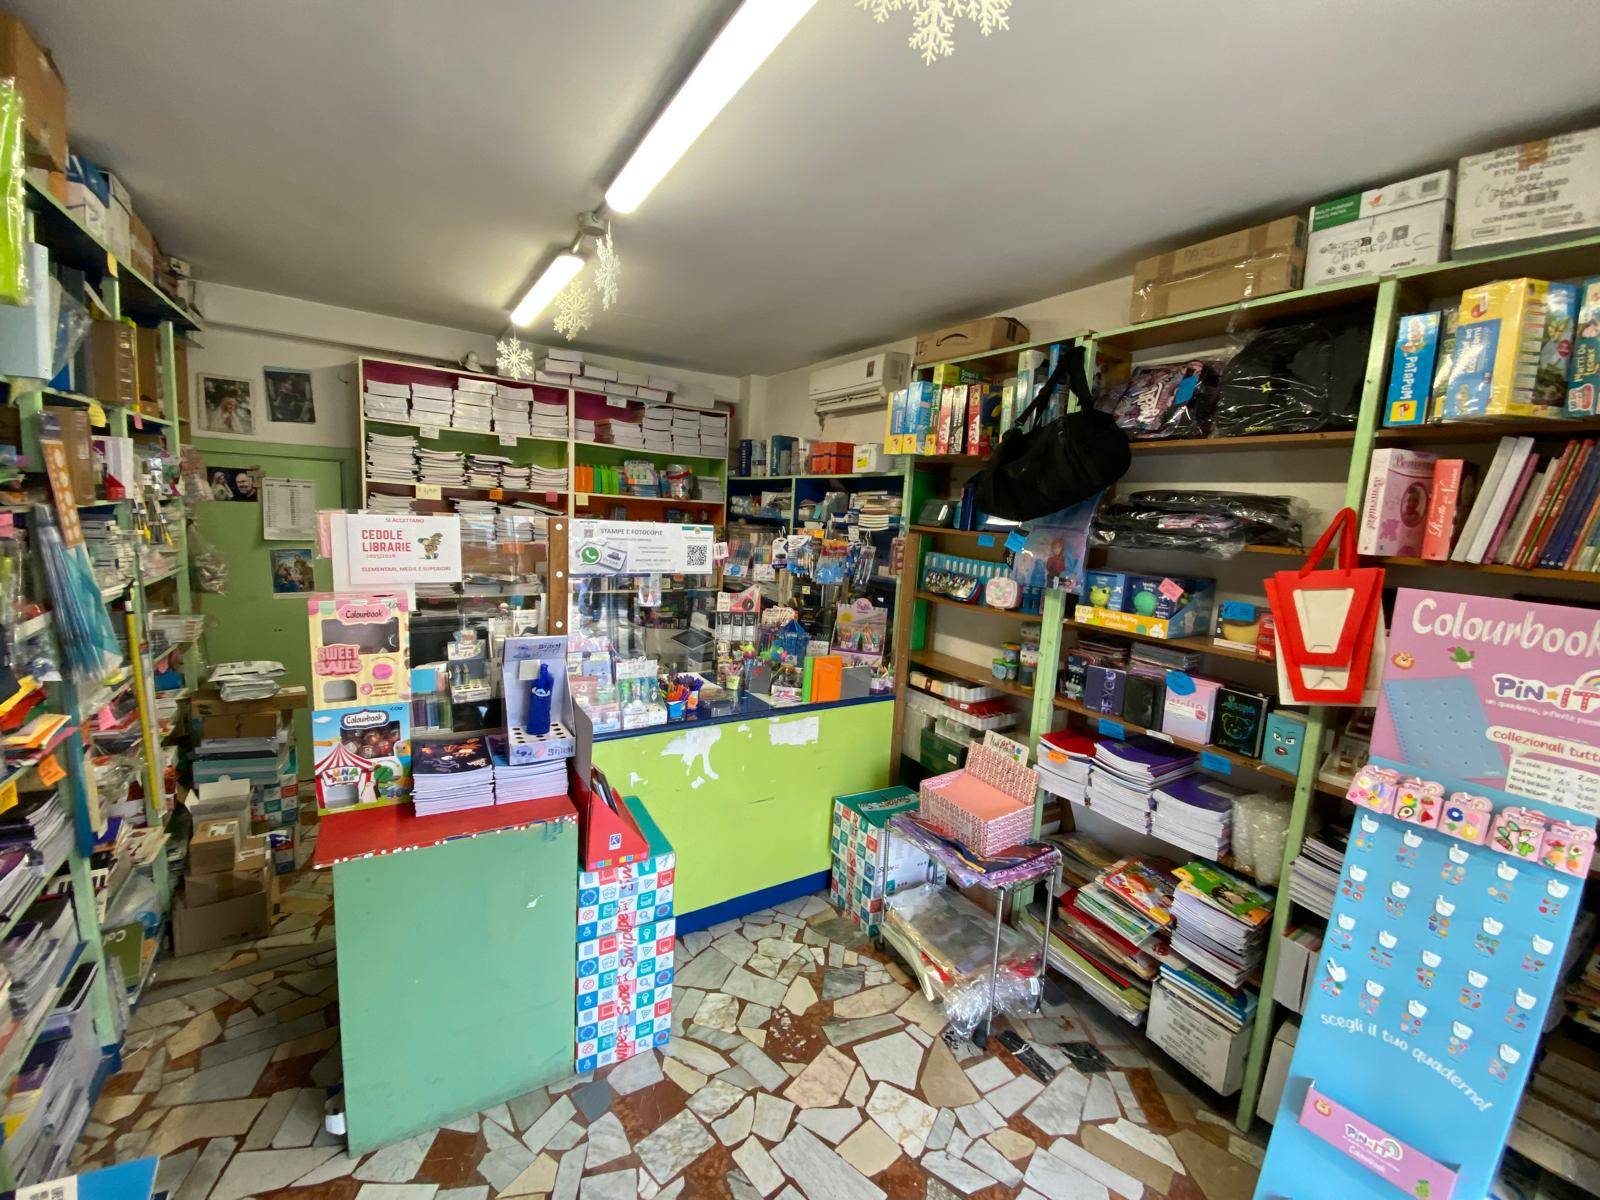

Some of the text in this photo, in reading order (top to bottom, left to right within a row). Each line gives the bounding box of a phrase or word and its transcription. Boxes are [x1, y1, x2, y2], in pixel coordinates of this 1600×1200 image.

[361, 529, 403, 540] CEDOLE
[362, 542, 412, 552] LIBRARIE
[345, 610, 384, 619] Colourbook
[1412, 597, 1600, 658] Colourbook
[319, 647, 358, 661] SWEET
[317, 660, 361, 674] BALLS
[346, 714, 383, 724] Colourbook
[1492, 730, 1565, 754] collezionali
[1320, 1011, 1494, 1113] scegli il tuo quaderno!
